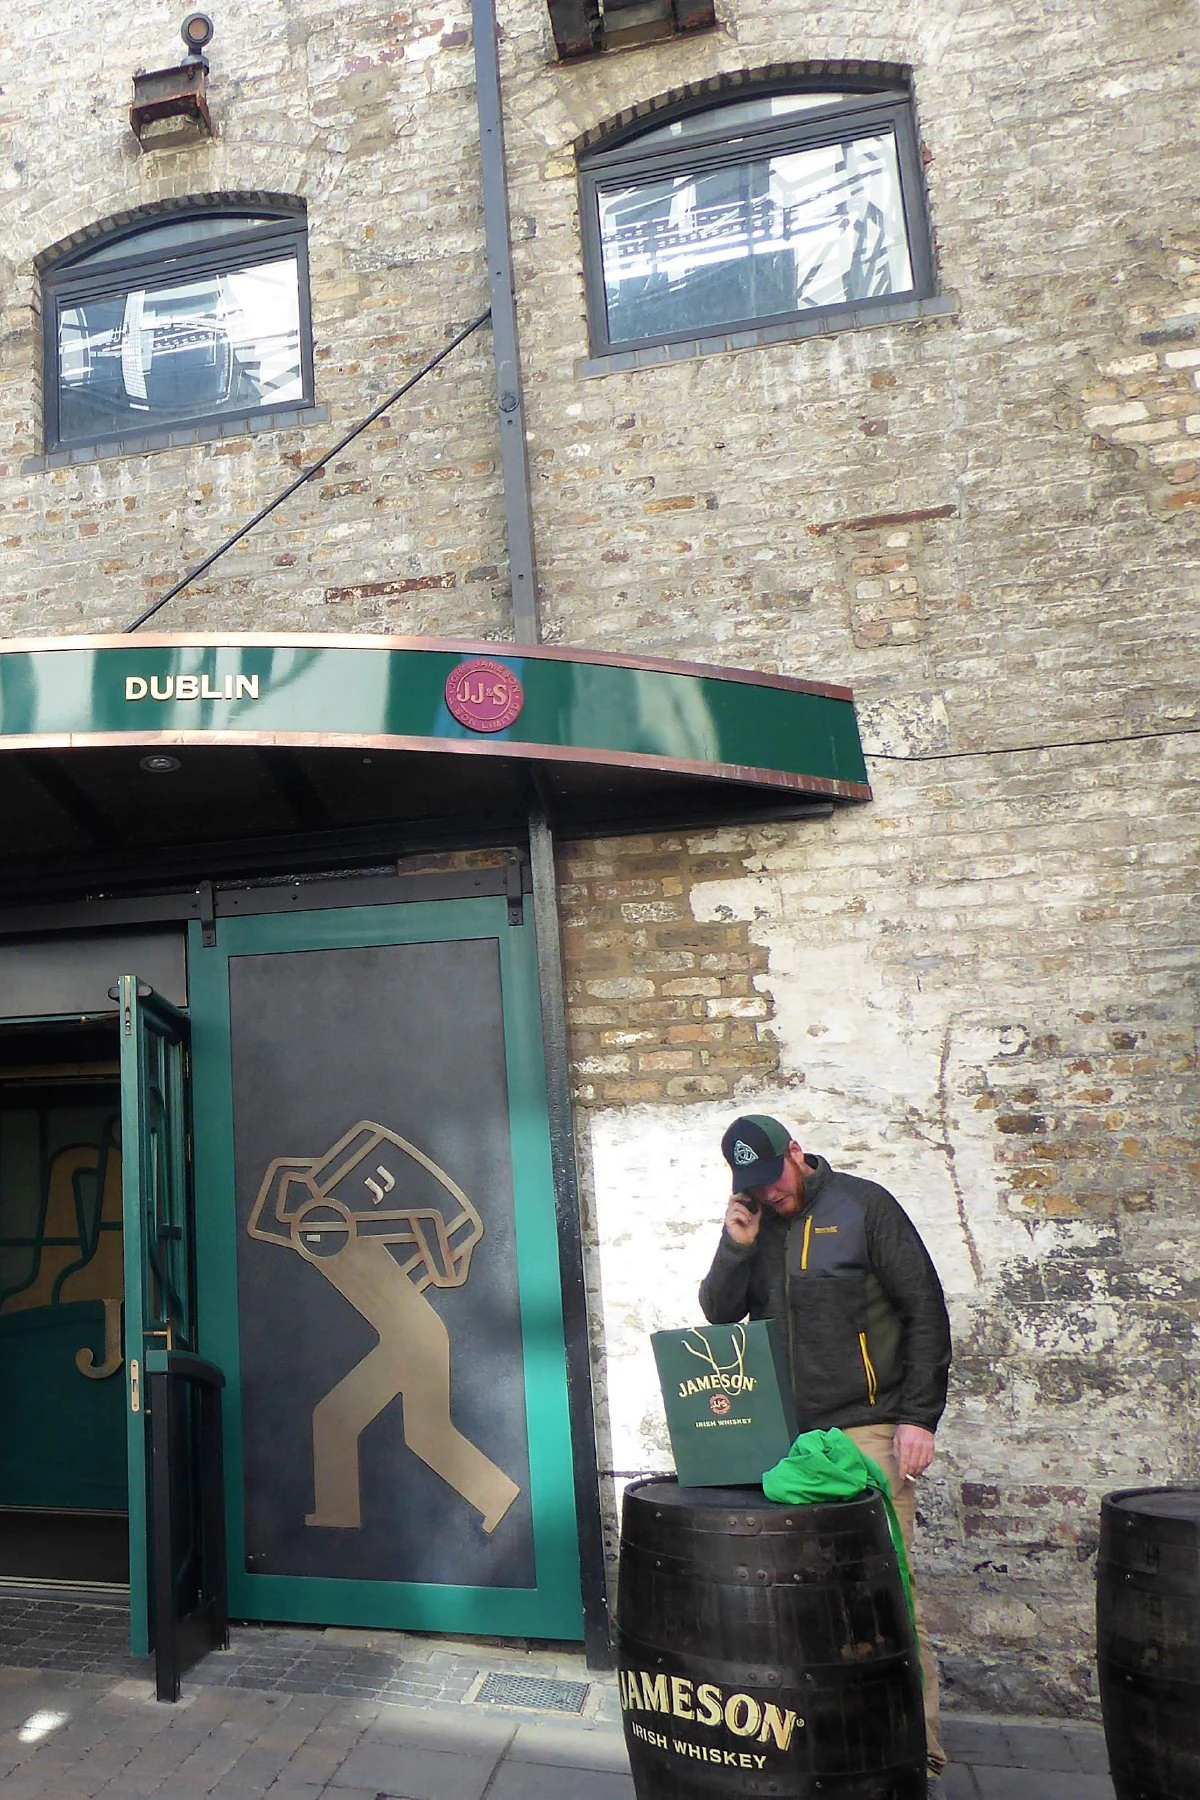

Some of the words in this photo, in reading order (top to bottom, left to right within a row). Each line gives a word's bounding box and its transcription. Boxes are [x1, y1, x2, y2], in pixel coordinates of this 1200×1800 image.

[125, 674, 259, 701] DUBLIN
[456, 681, 507, 706] JJ&S
[363, 1164, 396, 1206] JJ
[678, 1373, 755, 1398] JAMESON
[695, 1420, 717, 1429] IRISH
[717, 1417, 752, 1427] WHISKEY
[619, 1670, 797, 1752] JAMESON
[632, 1721, 669, 1751] IRISH
[672, 1738, 767, 1770] WHISKEY
